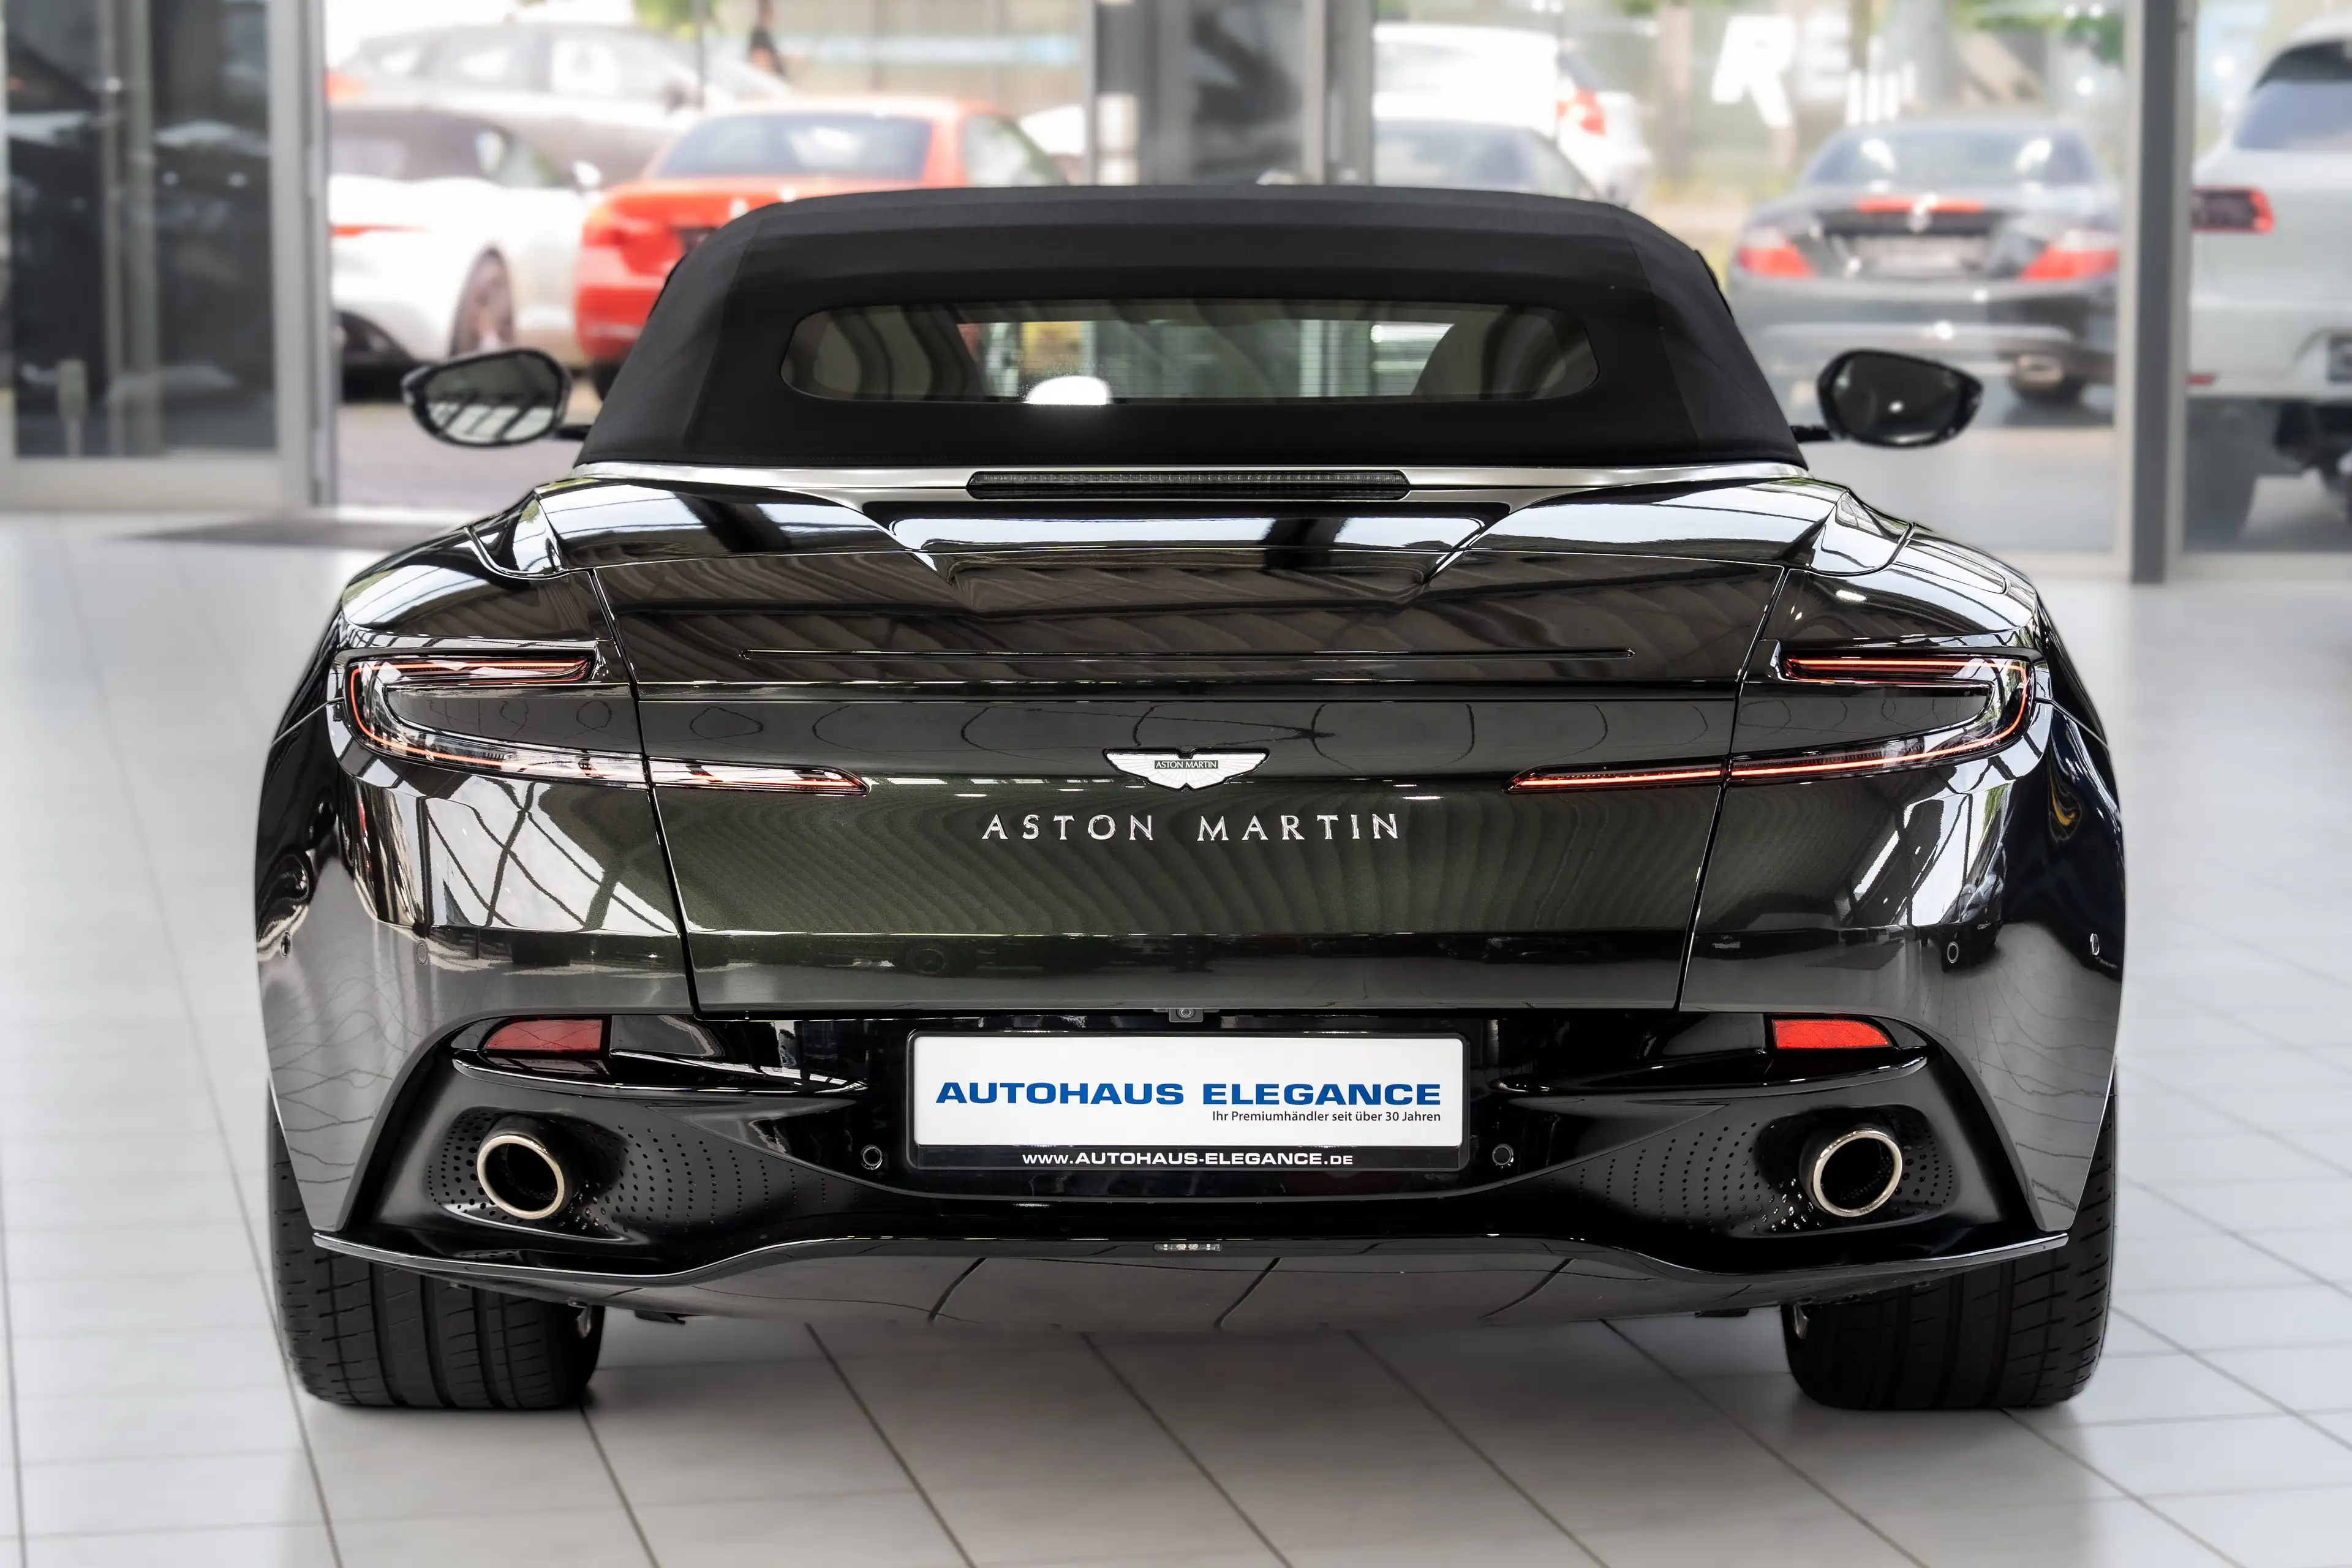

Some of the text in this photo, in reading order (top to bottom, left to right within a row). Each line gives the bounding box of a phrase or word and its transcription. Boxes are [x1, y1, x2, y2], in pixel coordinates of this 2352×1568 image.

[981, 813, 1398, 842] ASTON MARTIN
[935, 1082, 1441, 1106] AUTOHAUS ELEGANCE
[1213, 1110, 1441, 1121] Ihr Premiumhändler seit über 30 Jahren
